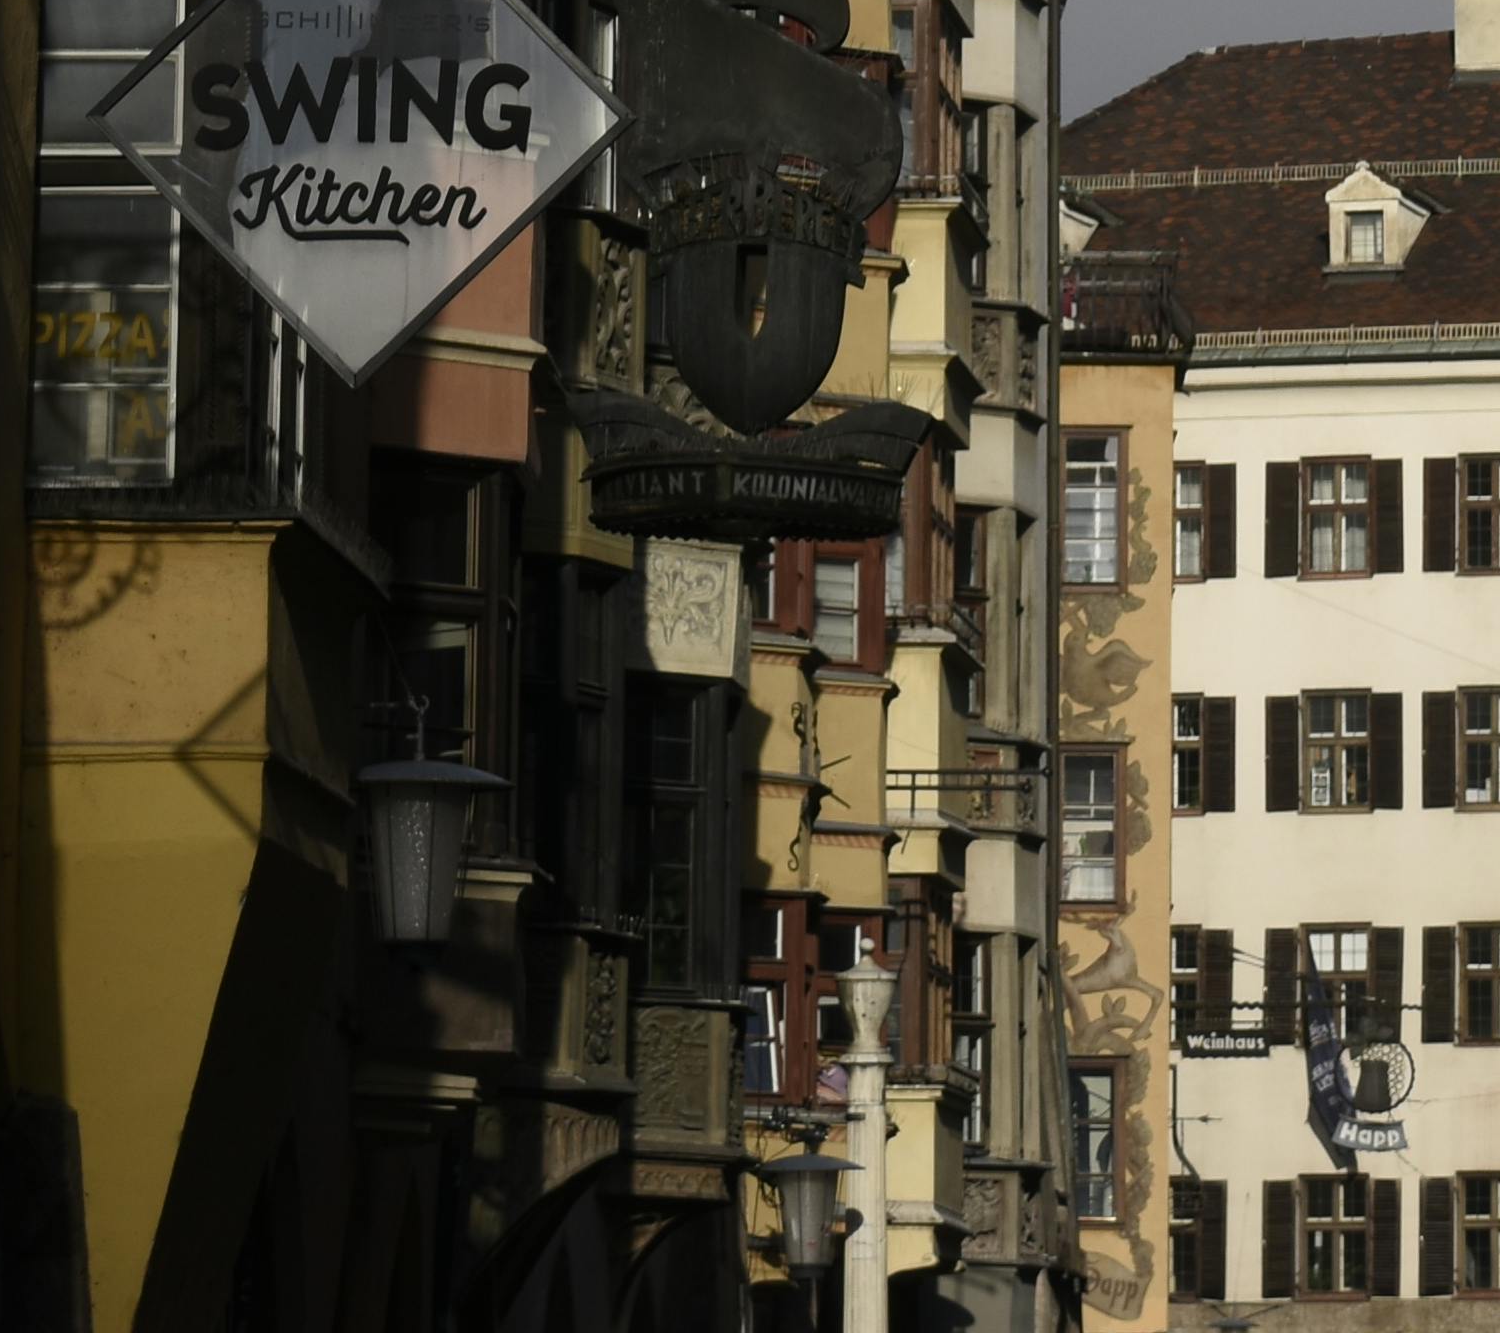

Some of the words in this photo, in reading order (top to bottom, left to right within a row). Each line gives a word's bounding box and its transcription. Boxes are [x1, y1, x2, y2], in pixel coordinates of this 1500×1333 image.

[192, 55, 532, 153] SWING
[233, 164, 486, 243] Kitchen
[1186, 1031, 1265, 1050] Weinhaus
[1339, 1121, 1401, 1148] Happ
